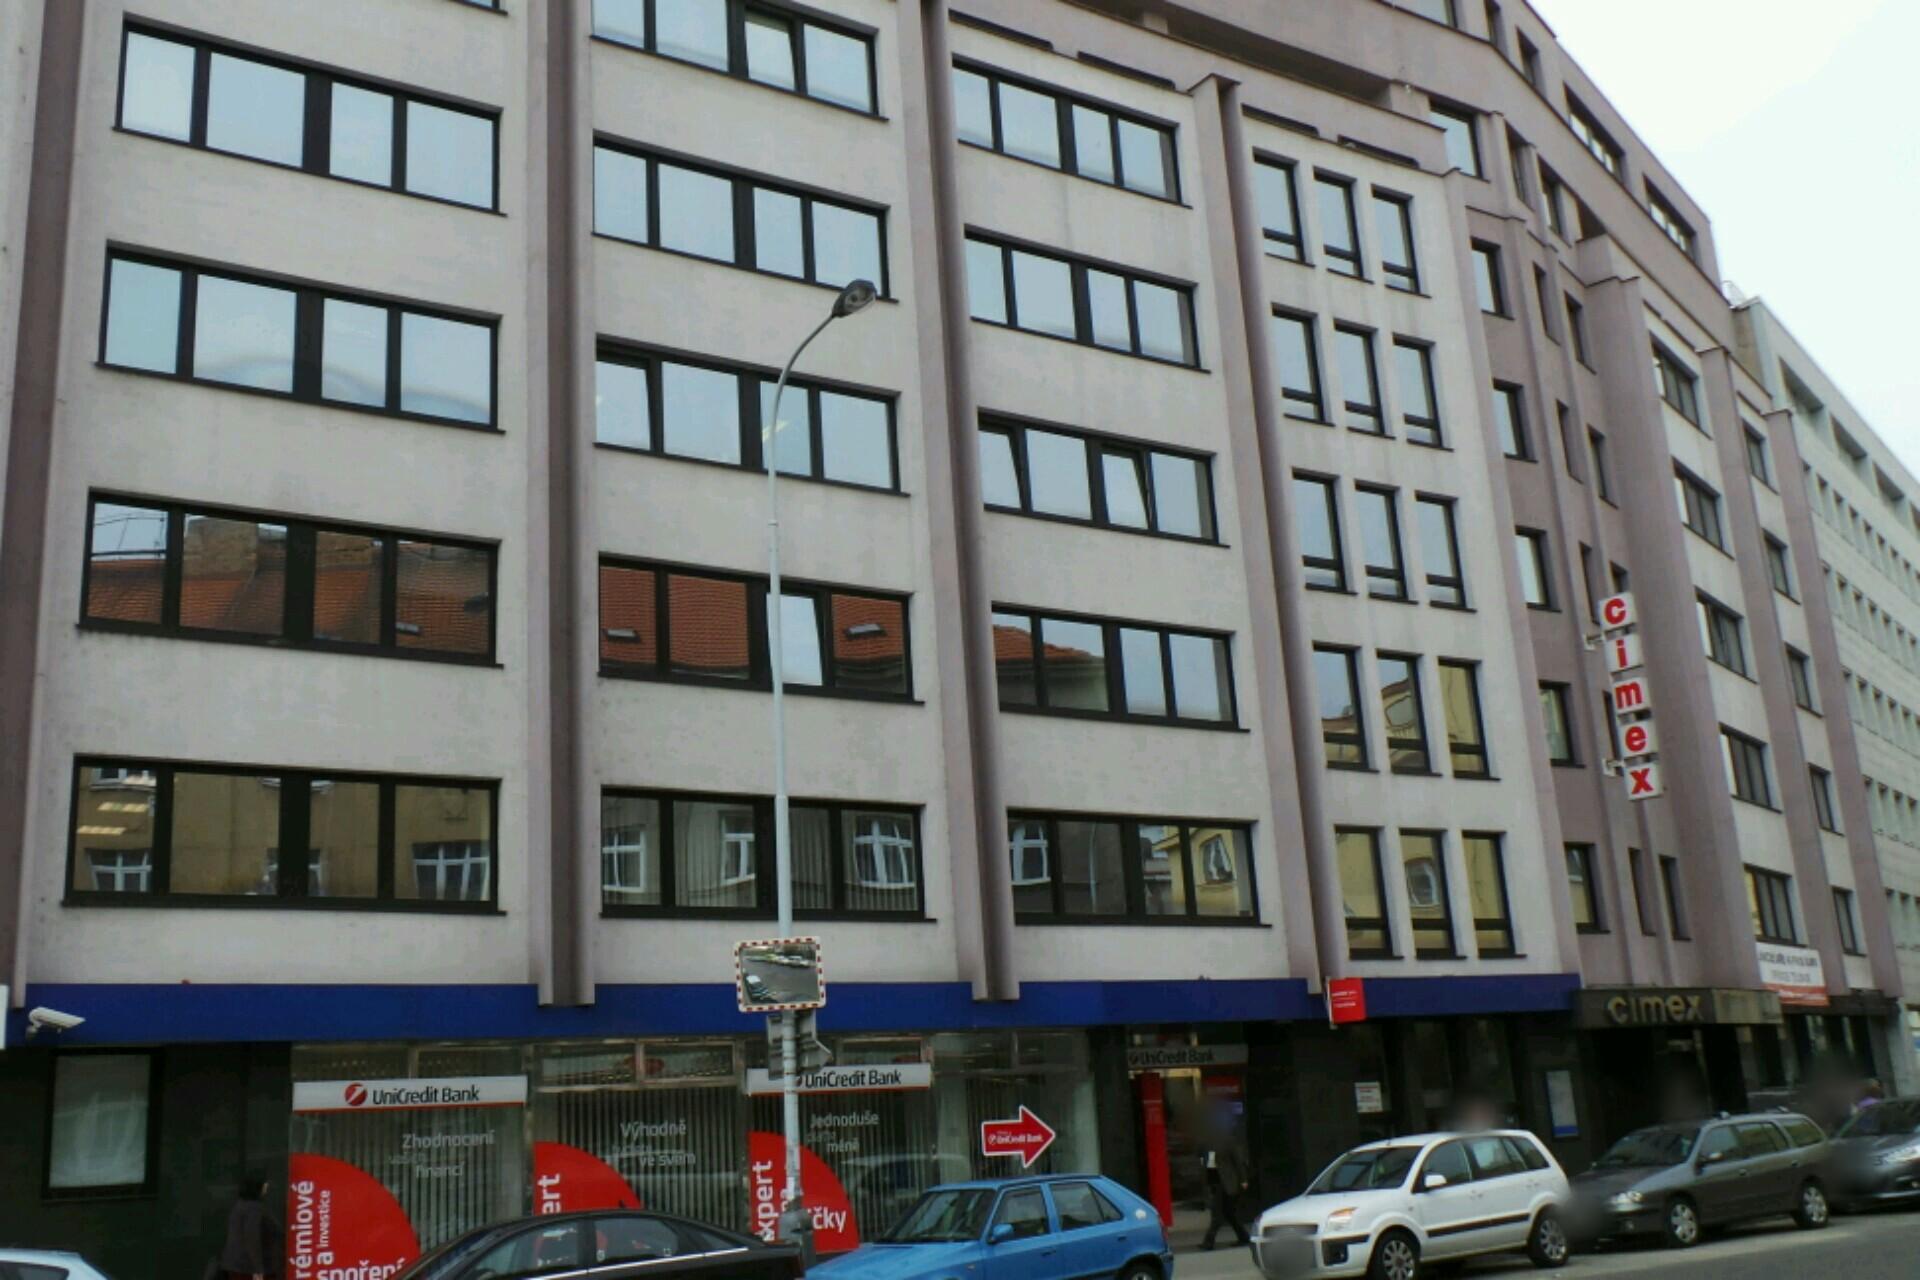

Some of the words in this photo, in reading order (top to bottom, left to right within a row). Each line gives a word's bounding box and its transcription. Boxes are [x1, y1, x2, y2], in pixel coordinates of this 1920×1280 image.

[1604, 598, 1653, 794] cimex
[1607, 995, 1702, 1024] cimex
[805, 1072, 865, 1088] UniCredit
[869, 1069, 901, 1085] Bank
[373, 1086, 438, 1104] UniCredit
[442, 1085, 480, 1102] Bank
[810, 1110, 879, 1128] Jednoduše
[402, 1130, 494, 1149] Zhodnocení
[317, 1190, 331, 1248] investice
[808, 1206, 847, 1233] čky
